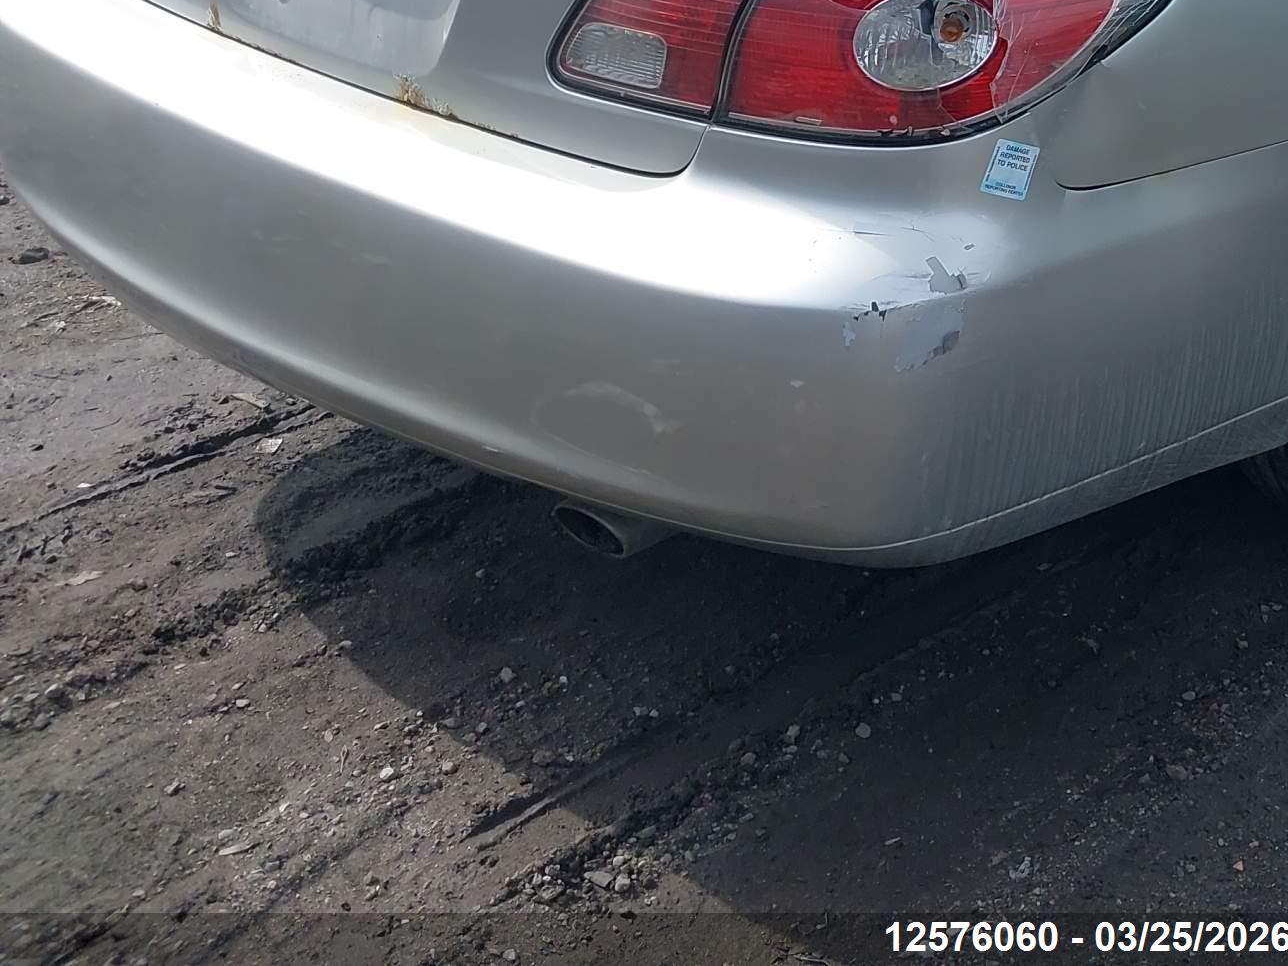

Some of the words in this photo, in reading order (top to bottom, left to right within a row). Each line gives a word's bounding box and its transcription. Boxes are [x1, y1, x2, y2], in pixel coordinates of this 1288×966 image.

[1006, 144, 1031, 155] DAMAGE
[999, 152, 1031, 164] REPORTED
[997, 159, 1006, 167] TO
[1006, 161, 1029, 172] POLICE
